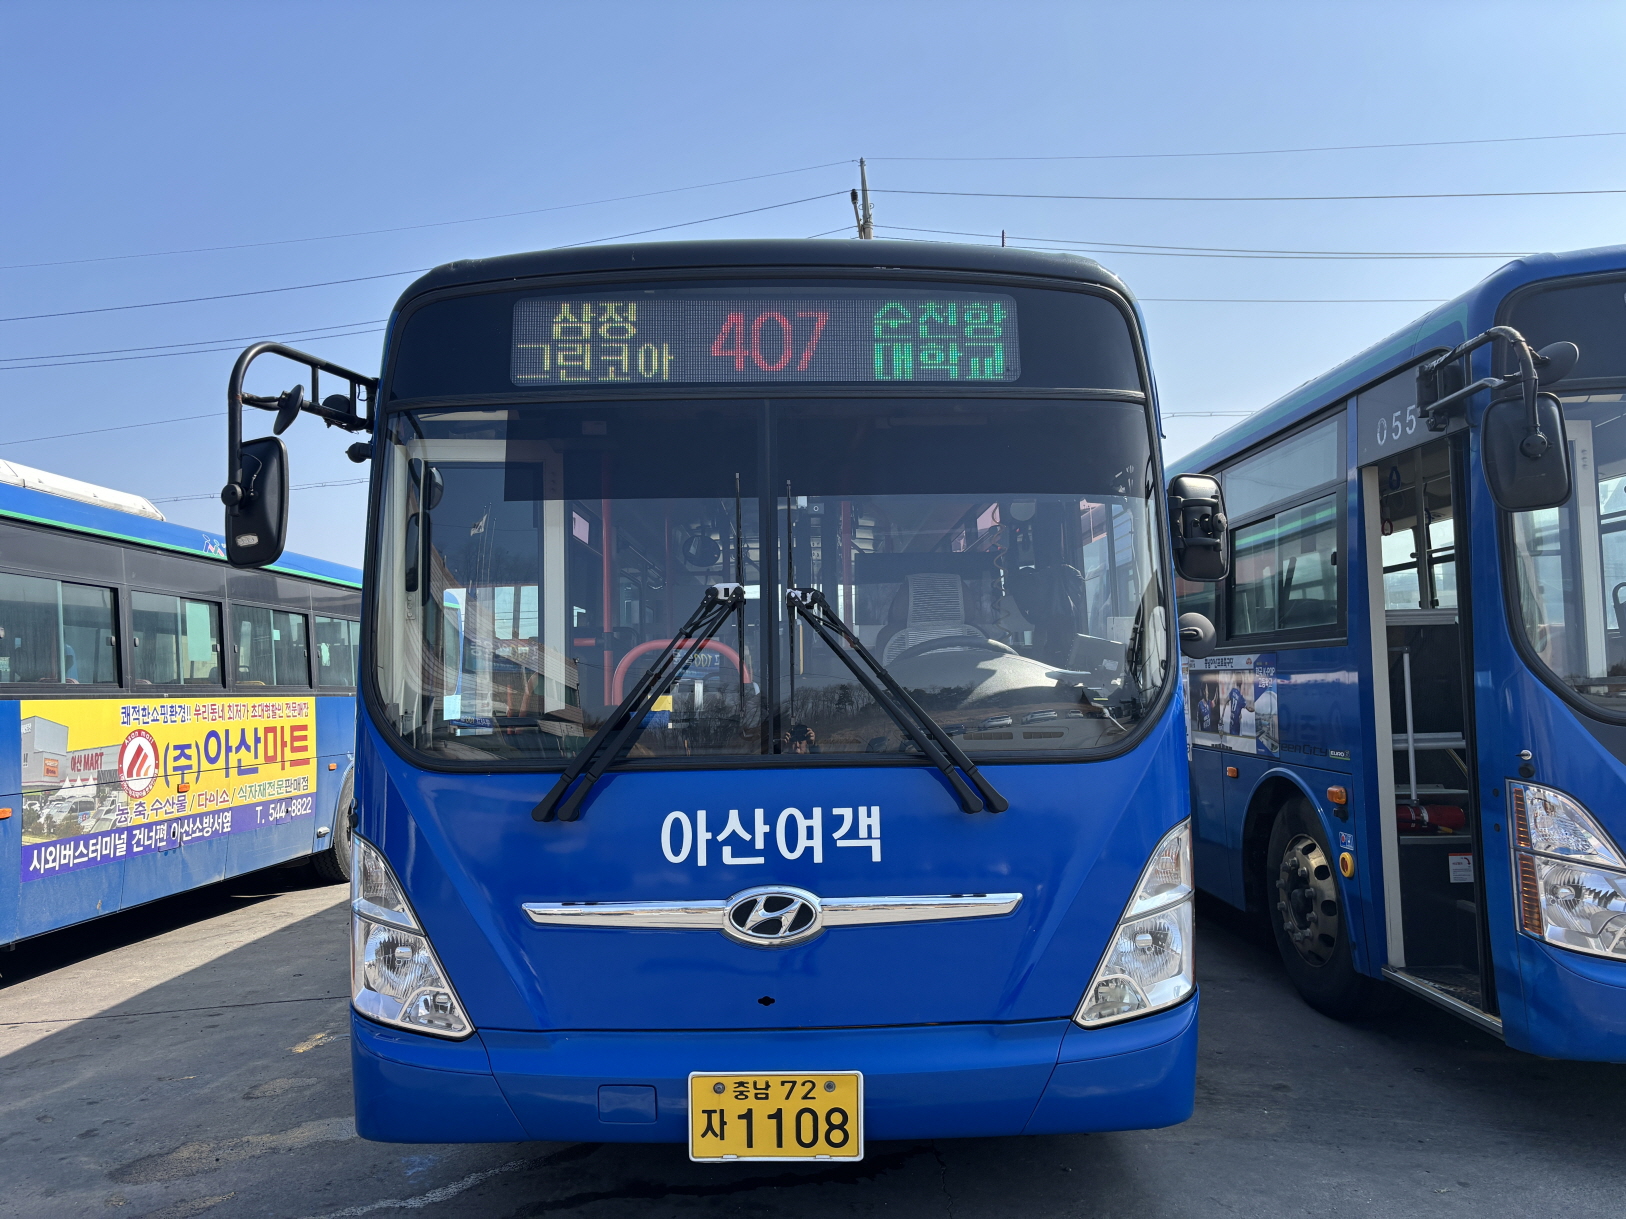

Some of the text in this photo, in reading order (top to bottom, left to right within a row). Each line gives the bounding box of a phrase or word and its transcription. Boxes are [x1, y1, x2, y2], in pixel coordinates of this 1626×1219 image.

[553, 302, 637, 340] 삼정
[874, 302, 1007, 339] 순천향
[711, 312, 829, 372] 407
[874, 342, 1004, 380] 대학교
[516, 342, 674, 381] 그린코아
[193, 703, 225, 722] 우리동네
[227, 702, 249, 720] 최저가
[251, 702, 284, 719] 초대형할인
[83, 752, 104, 771] MART
[197, 789, 230, 809] 다이소
[29, 830, 128, 874] 시외버스터미널
[131, 822, 168, 853] 건너편
[170, 811, 232, 844] 아산소방서옆
[268, 797, 312, 821] 544-8822
[660, 805, 882, 867] 아산여객
[732, 1079, 817, 1101] 충남 72
